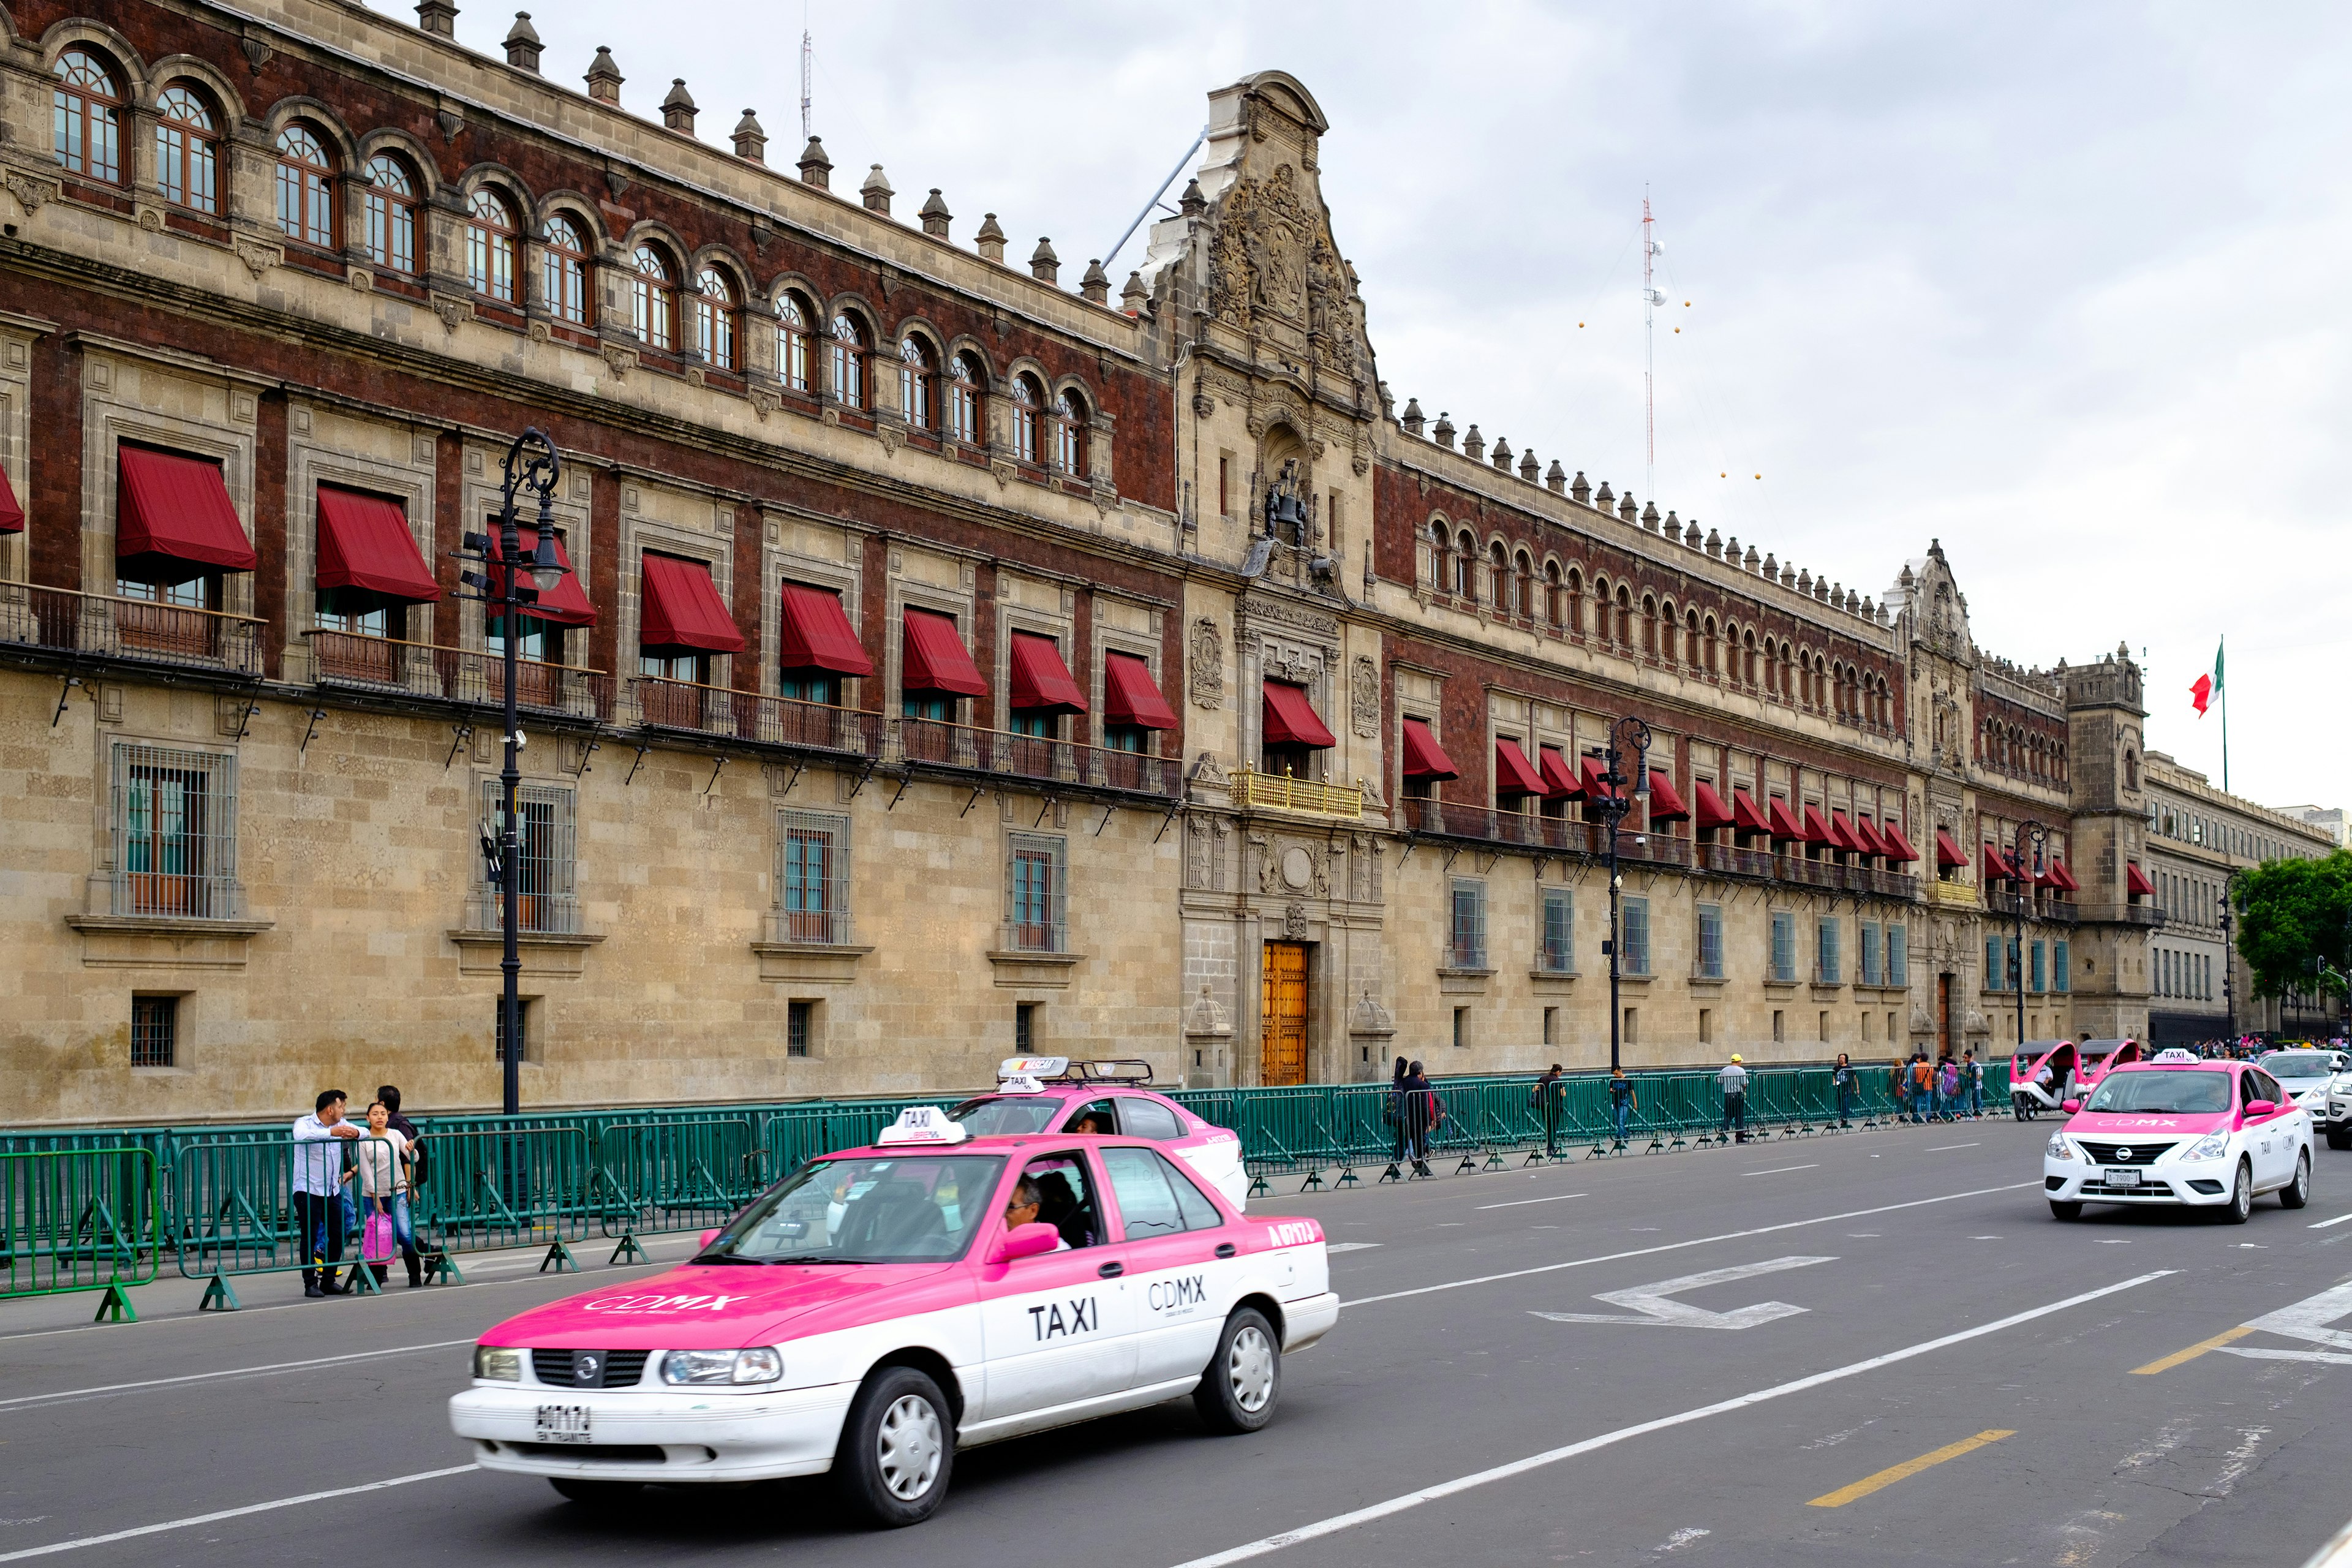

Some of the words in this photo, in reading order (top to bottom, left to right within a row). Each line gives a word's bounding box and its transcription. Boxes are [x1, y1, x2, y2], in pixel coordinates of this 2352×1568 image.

[1023, 1060, 1055, 1069] NASCAR
[905, 1110, 931, 1128] TAXI
[2261, 1140, 2271, 1155] TAXI
[2283, 1134, 2294, 1149] CDMX
[1148, 1275, 1206, 1311] CDMX
[584, 1295, 752, 1310] CDMX
[1028, 1297, 1098, 1341] TAXI
[537, 1431, 548, 1441] EN
[552, 1432, 592, 1444] TRAMITE
